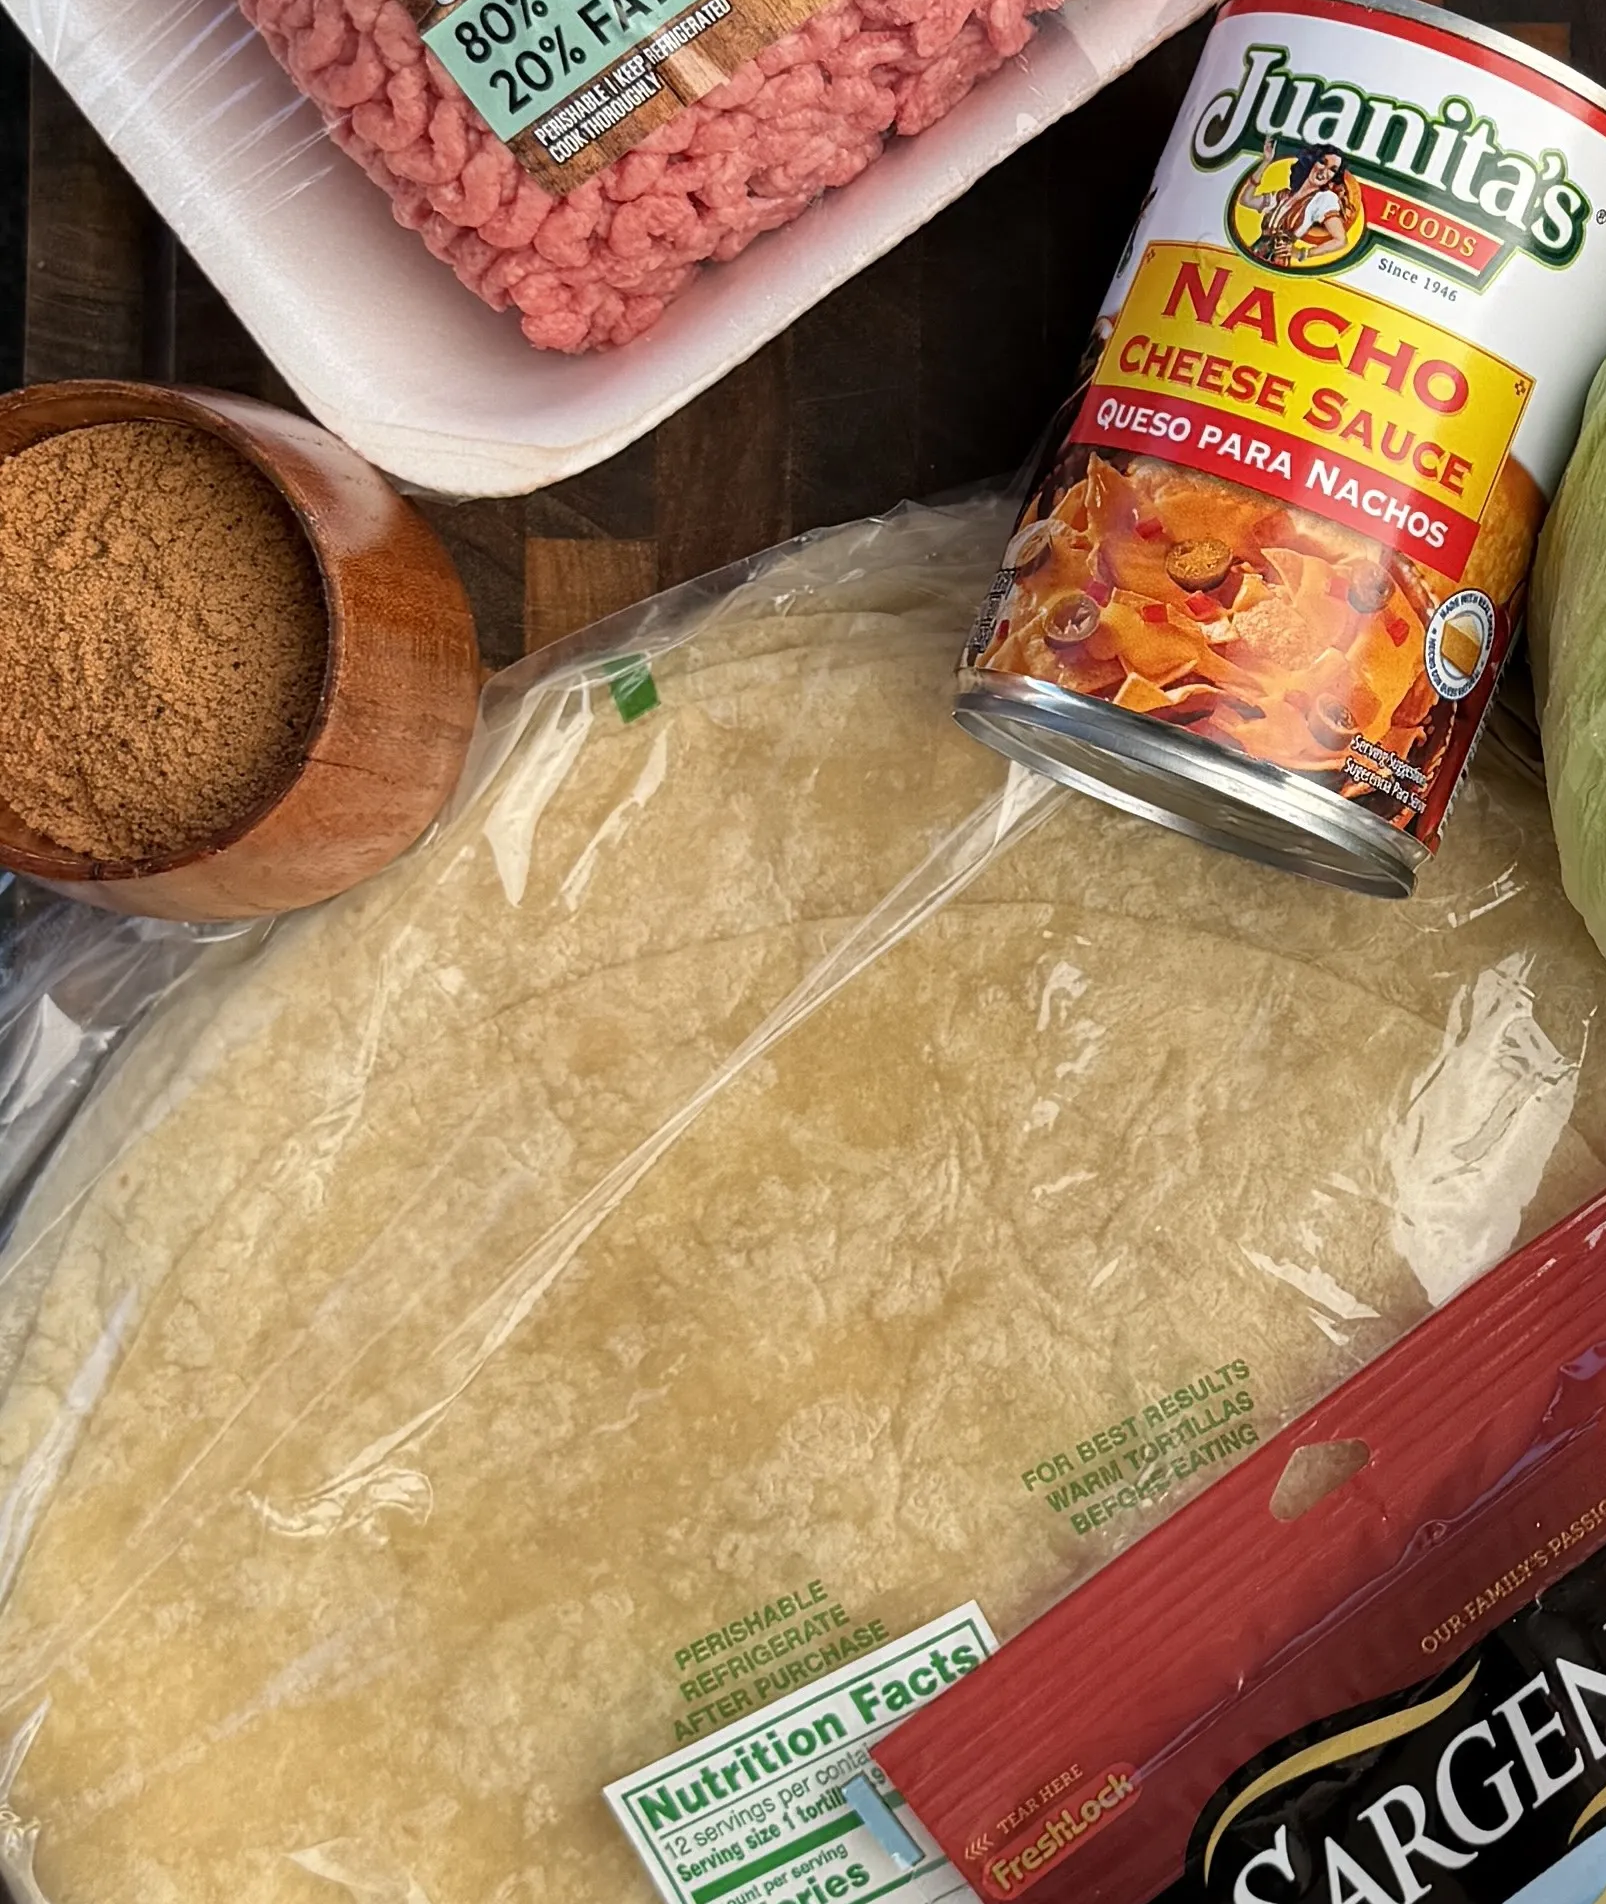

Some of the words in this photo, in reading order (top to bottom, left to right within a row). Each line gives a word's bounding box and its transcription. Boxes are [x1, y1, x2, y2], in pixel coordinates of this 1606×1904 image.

[487, 22, 589, 116] 20%
[534, 84, 610, 148] PERISHABLE
[614, 55, 650, 89] KEEP
[548, 128, 587, 165] COOK
[577, 73, 663, 142] THOROUGHLY
[1198, 49, 1586, 254] Juanita's
[1376, 256, 1420, 286] Since
[1422, 276, 1459, 302] 1946
[1379, 199, 1479, 258] FOODS
[1162, 259, 1470, 415] NACHO
[1098, 398, 1193, 444] QUESO
[1196, 423, 1289, 480] PARA
[1305, 458, 1450, 549] NACHOS
[1119, 334, 1295, 415] CHEESE
[1302, 386, 1474, 496] SAUCE
[1020, 1451, 1074, 1493] FOR
[1074, 1414, 1142, 1463] BEST
[1140, 1356, 1252, 1428] RESULTS
[1044, 1459, 1124, 1514] WARM
[1123, 1389, 1255, 1472] TORTILLAS
[1069, 1468, 1171, 1536] BEFORE
[1170, 1420, 1260, 1481] EATING
[669, 1686, 753, 1742] AFTER
[753, 1616, 891, 1700] PURCHASE
[672, 1578, 829, 1671] PERISHABLE
[678, 1602, 850, 1704] REFRIGERATE
[637, 1700, 848, 1833] Nutrition
[848, 1633, 983, 1726] Facts
[989, 1772, 1135, 1891] FreshLock
[995, 1797, 1040, 1835] TEAR
[1038, 1763, 1084, 1802] HERE
